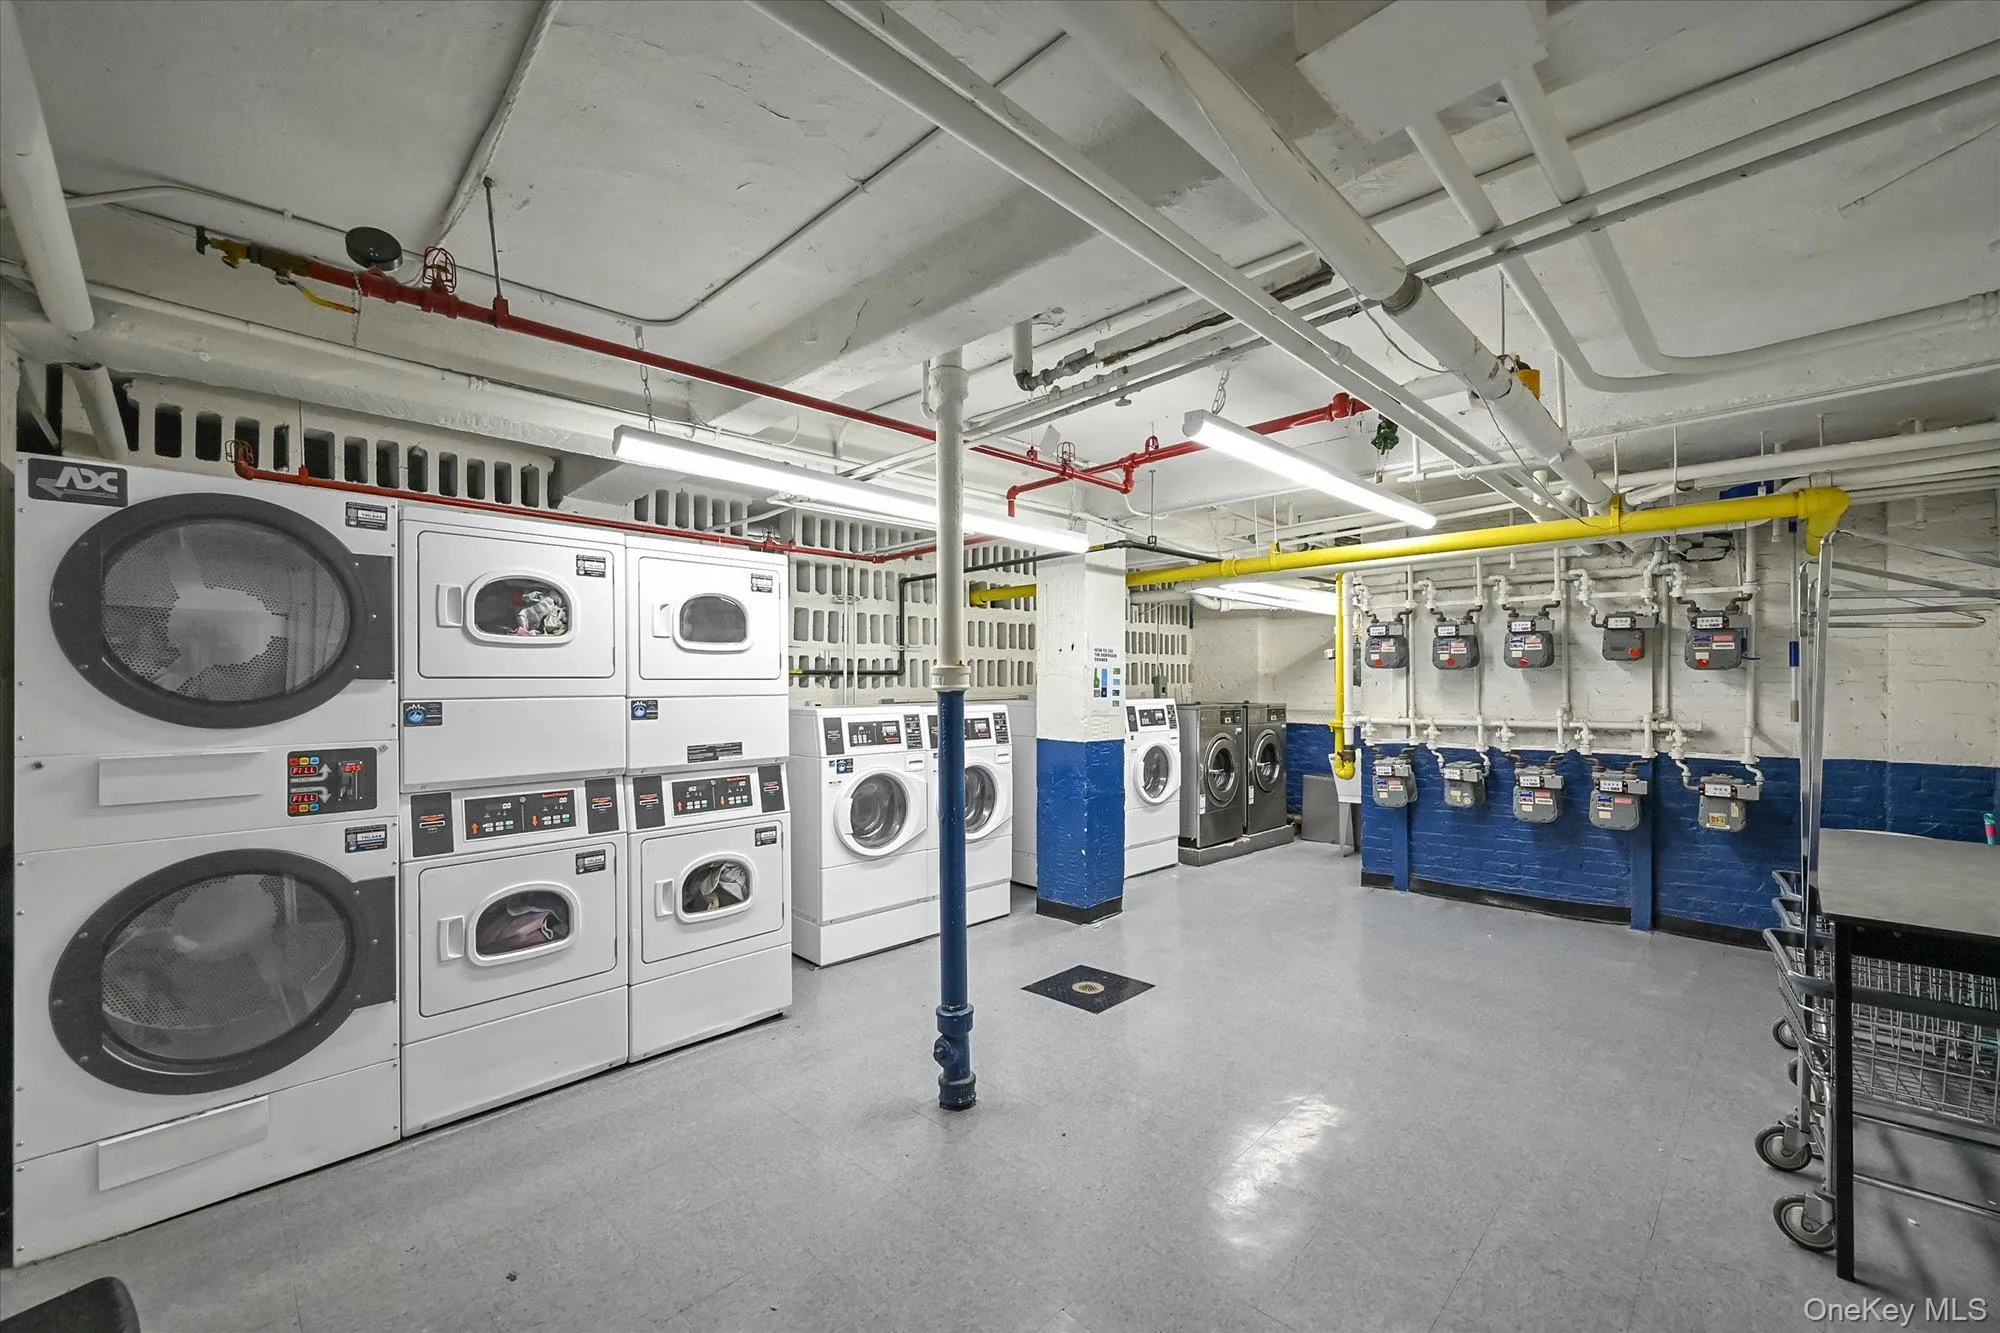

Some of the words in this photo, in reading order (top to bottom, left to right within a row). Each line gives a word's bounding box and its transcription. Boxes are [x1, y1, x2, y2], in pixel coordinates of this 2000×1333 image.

[56, 466, 118, 494] ADC
[292, 766, 315, 775] FILL
[292, 794, 315, 803] FILL
